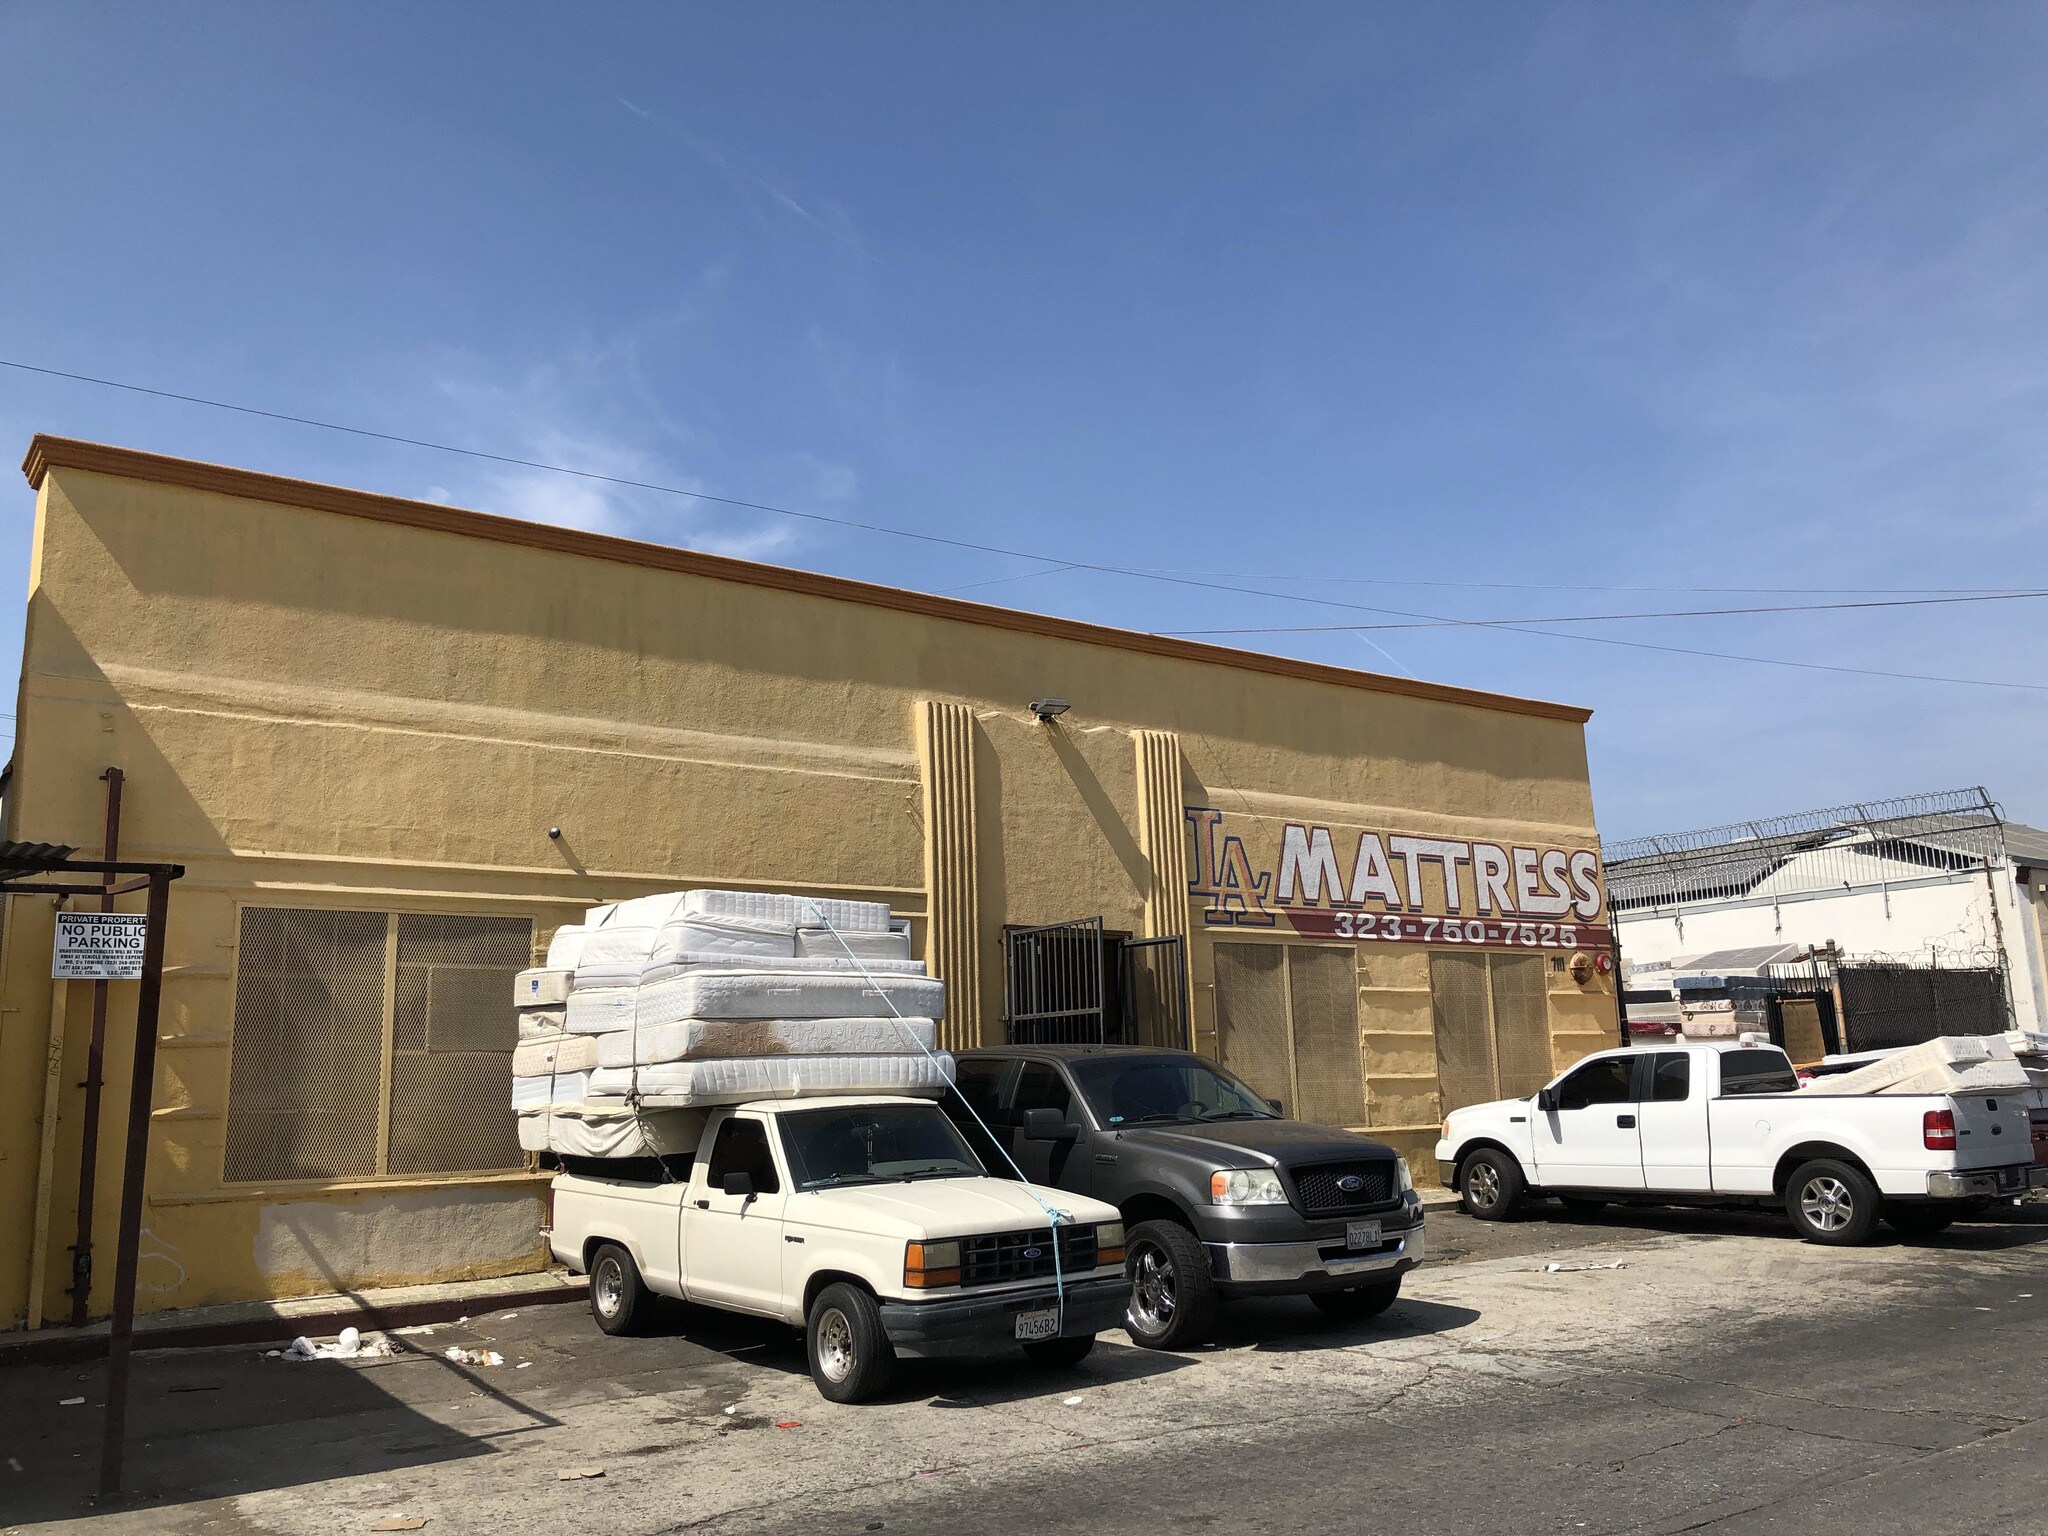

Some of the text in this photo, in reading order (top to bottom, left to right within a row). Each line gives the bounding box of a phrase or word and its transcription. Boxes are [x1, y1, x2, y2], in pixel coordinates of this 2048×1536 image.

[1184, 806, 1601, 927] LA MATTRESS
[61, 915, 147, 924] PRIVATE PROPERT
[62, 925, 147, 937] NO PUBLIC
[1333, 911, 1578, 950] 323-750-7525
[68, 937, 140, 948] PARKING
[1018, 1318, 1055, 1337] 97456B2
